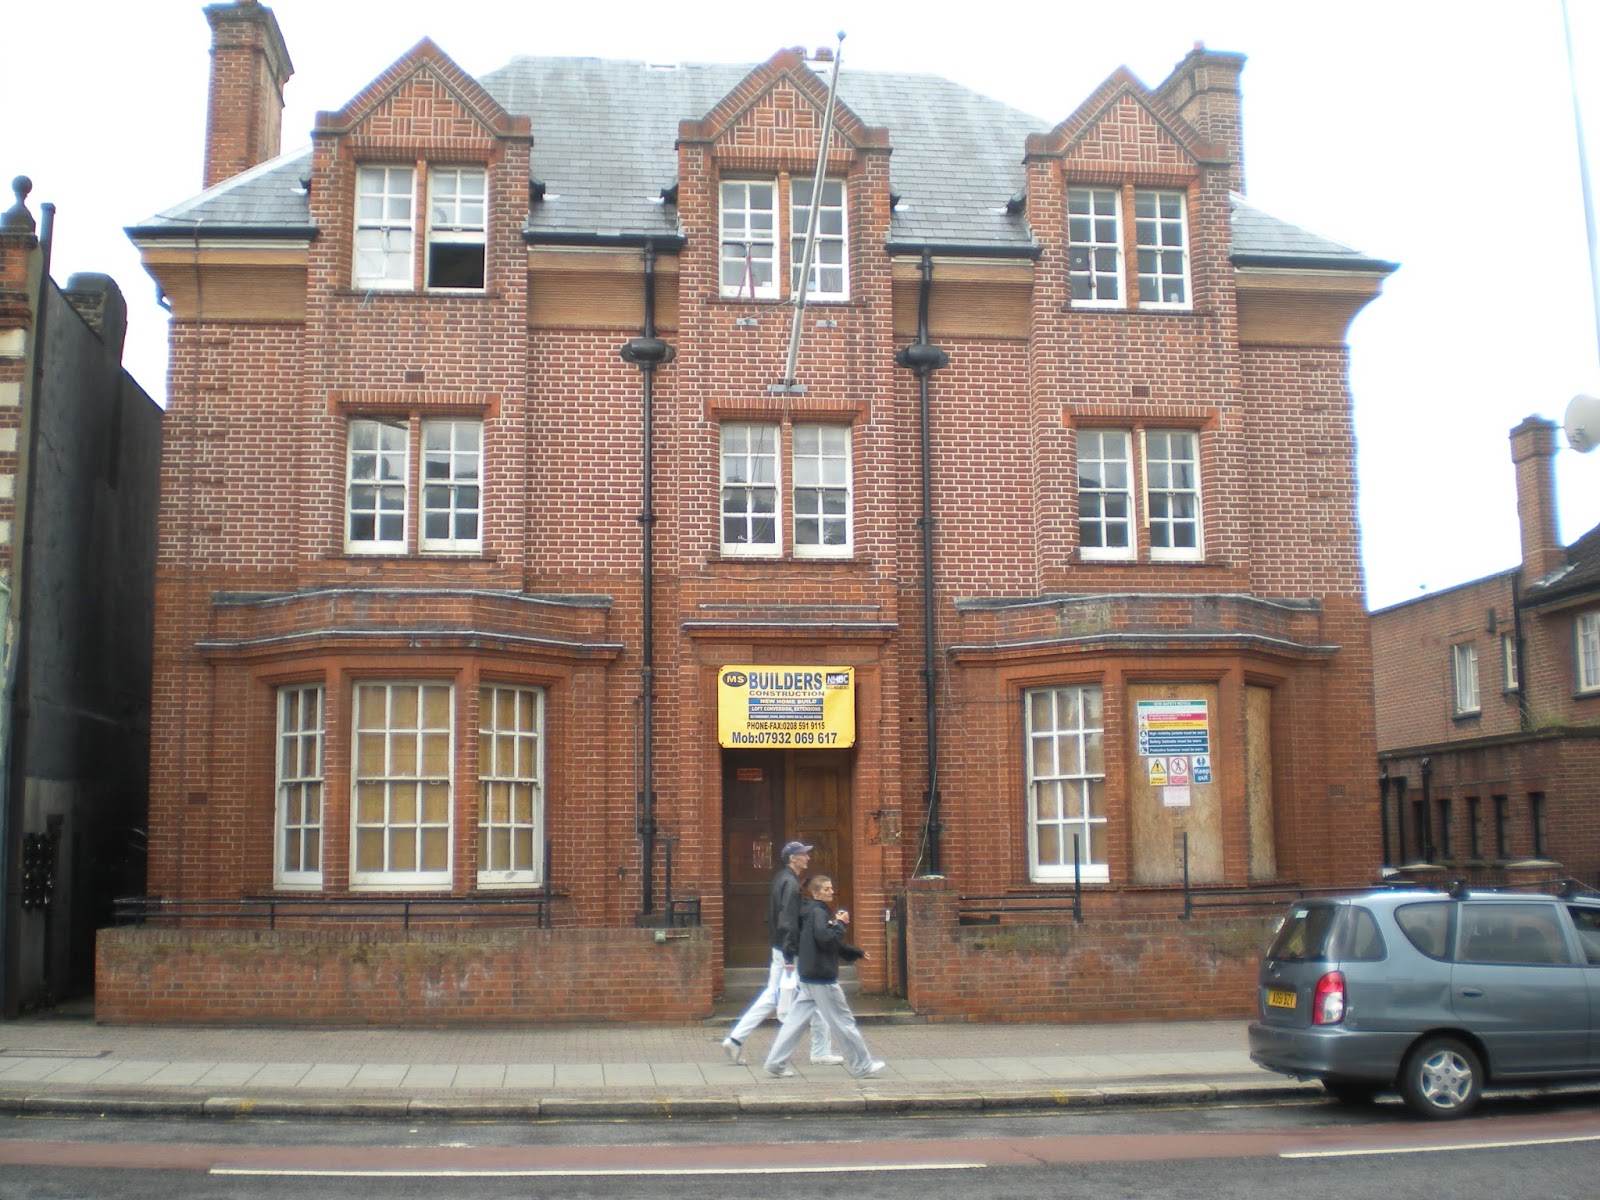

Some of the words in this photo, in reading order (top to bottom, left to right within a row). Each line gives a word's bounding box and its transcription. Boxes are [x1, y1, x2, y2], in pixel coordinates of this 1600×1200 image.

[726, 675, 745, 683] MS
[749, 672, 823, 690] BUILDERS
[798, 722, 809, 730] 591
[810, 722, 825, 730] 9115
[732, 732, 791, 744] Mob:07932
[794, 732, 814, 744] 069
[817, 732, 838, 744] 617
